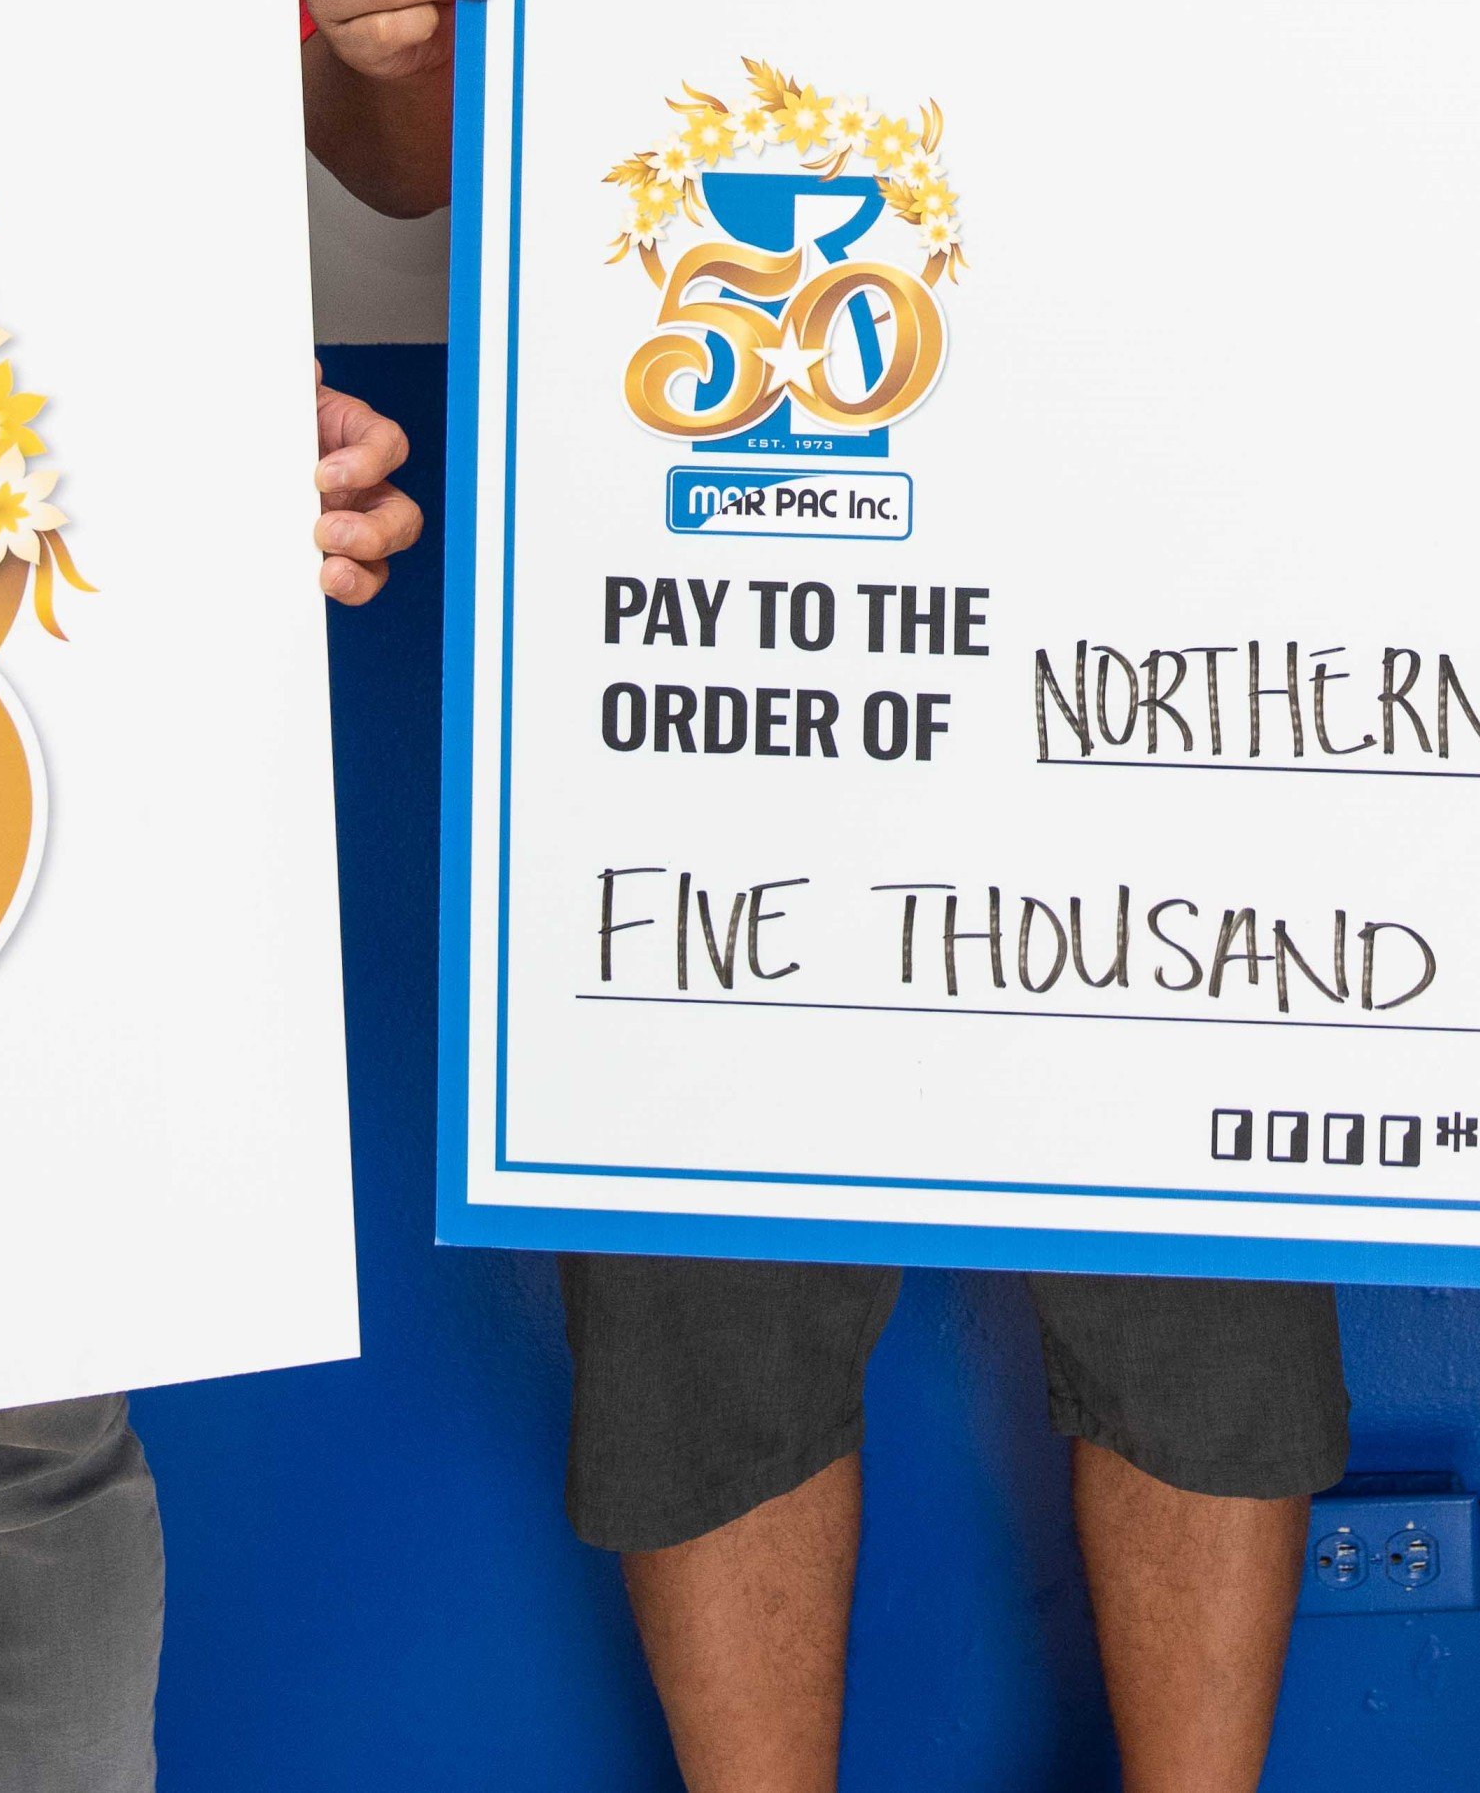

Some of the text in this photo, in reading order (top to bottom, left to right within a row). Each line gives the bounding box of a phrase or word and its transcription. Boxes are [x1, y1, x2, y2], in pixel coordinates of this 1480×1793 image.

[623, 241, 944, 438] 50
[747, 438, 834, 450] EST. 1973
[775, 487, 837, 518] PAC
[849, 490, 898, 521] Inc.
[603, 576, 991, 657] PAY TO THE
[600, 681, 952, 762] ORDER OF
[596, 866, 1438, 1014] FIVE THOUSAND
